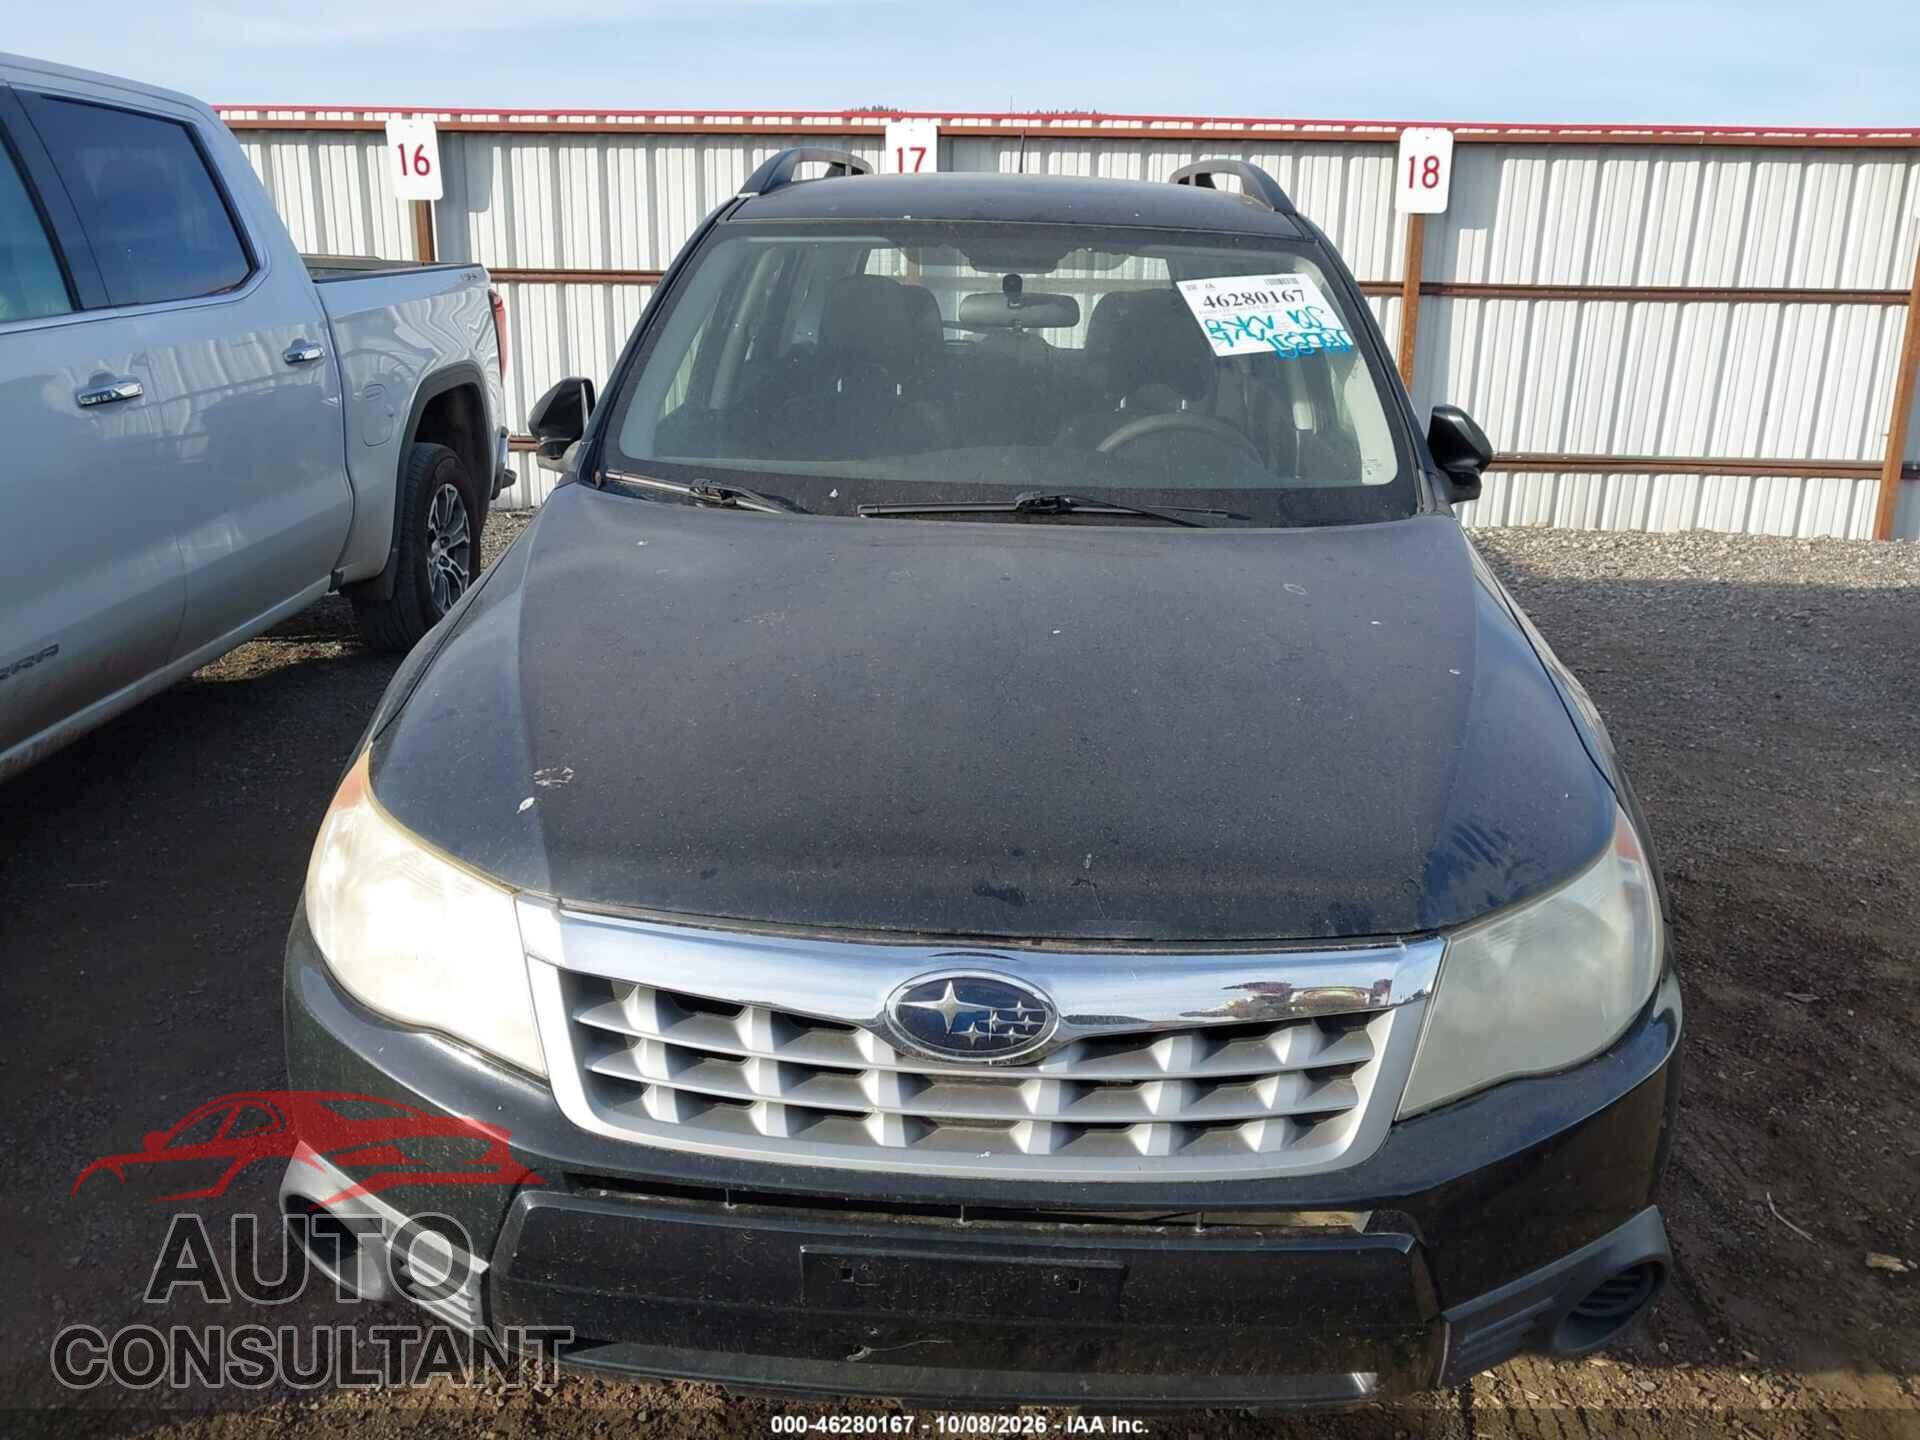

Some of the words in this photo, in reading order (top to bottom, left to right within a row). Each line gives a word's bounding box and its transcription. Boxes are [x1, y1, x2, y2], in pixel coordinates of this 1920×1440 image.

[398, 143, 430, 176] 16
[897, 147, 926, 175] 17
[1409, 155, 1440, 189] 18
[1203, 289, 1304, 308] 46280167
